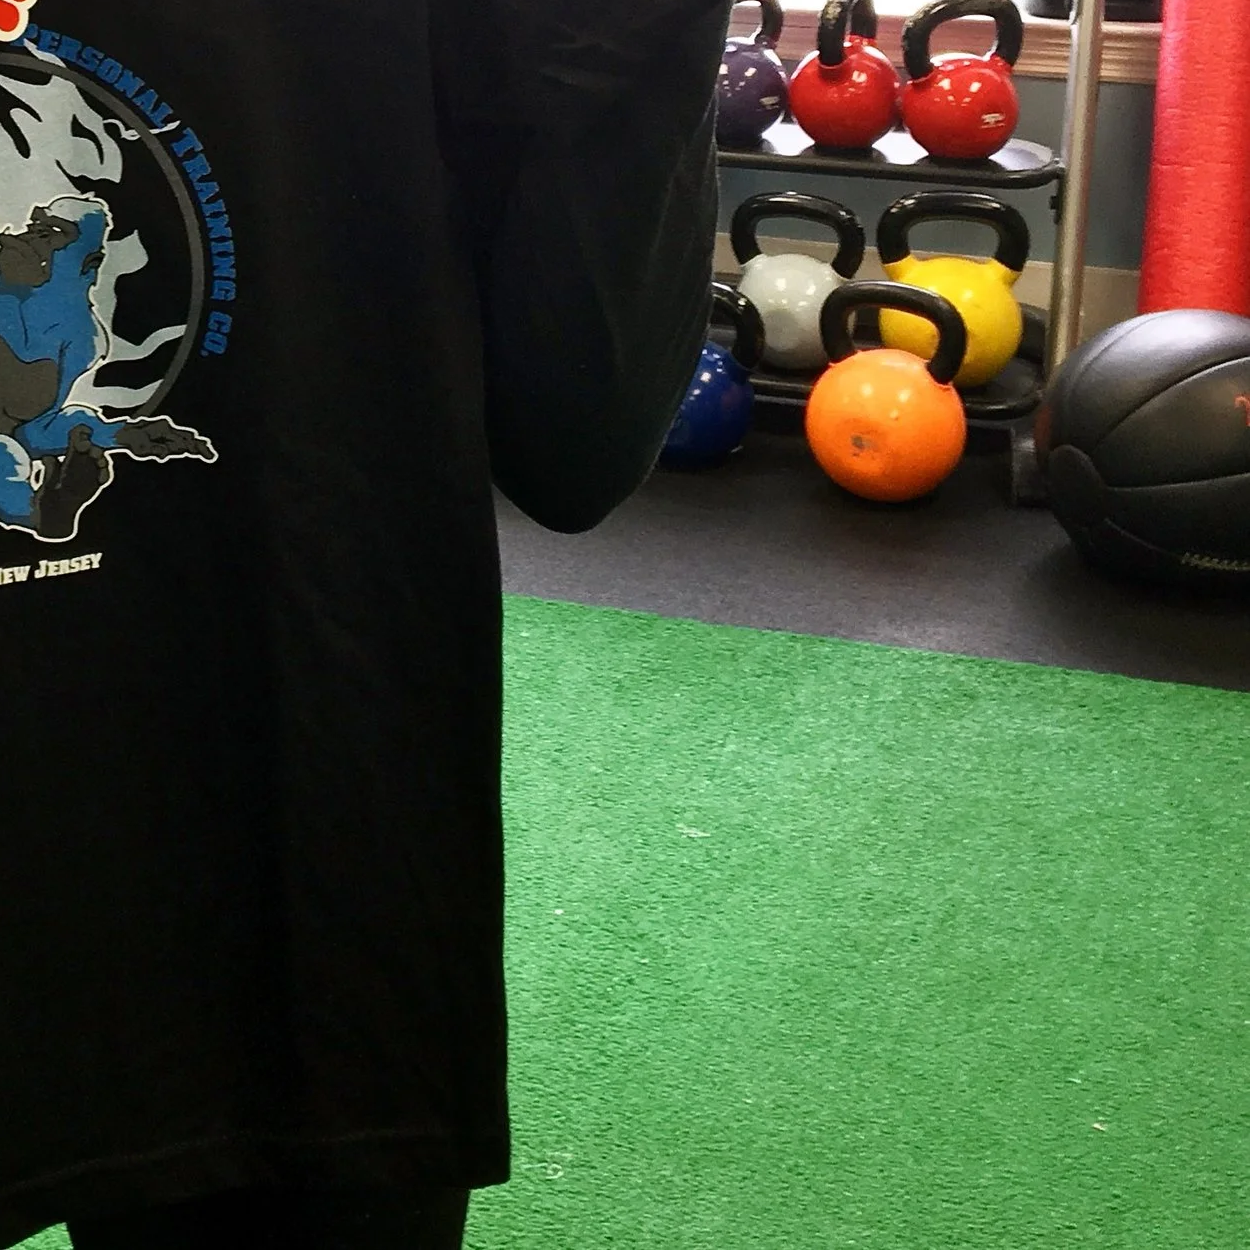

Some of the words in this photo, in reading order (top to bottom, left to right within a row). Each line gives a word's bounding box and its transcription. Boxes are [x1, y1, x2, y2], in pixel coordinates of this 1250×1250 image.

[10, 23, 175, 128] PERSONAL
[171, 126, 236, 302] TRAINING
[34, 552, 103, 579] JERSEY
